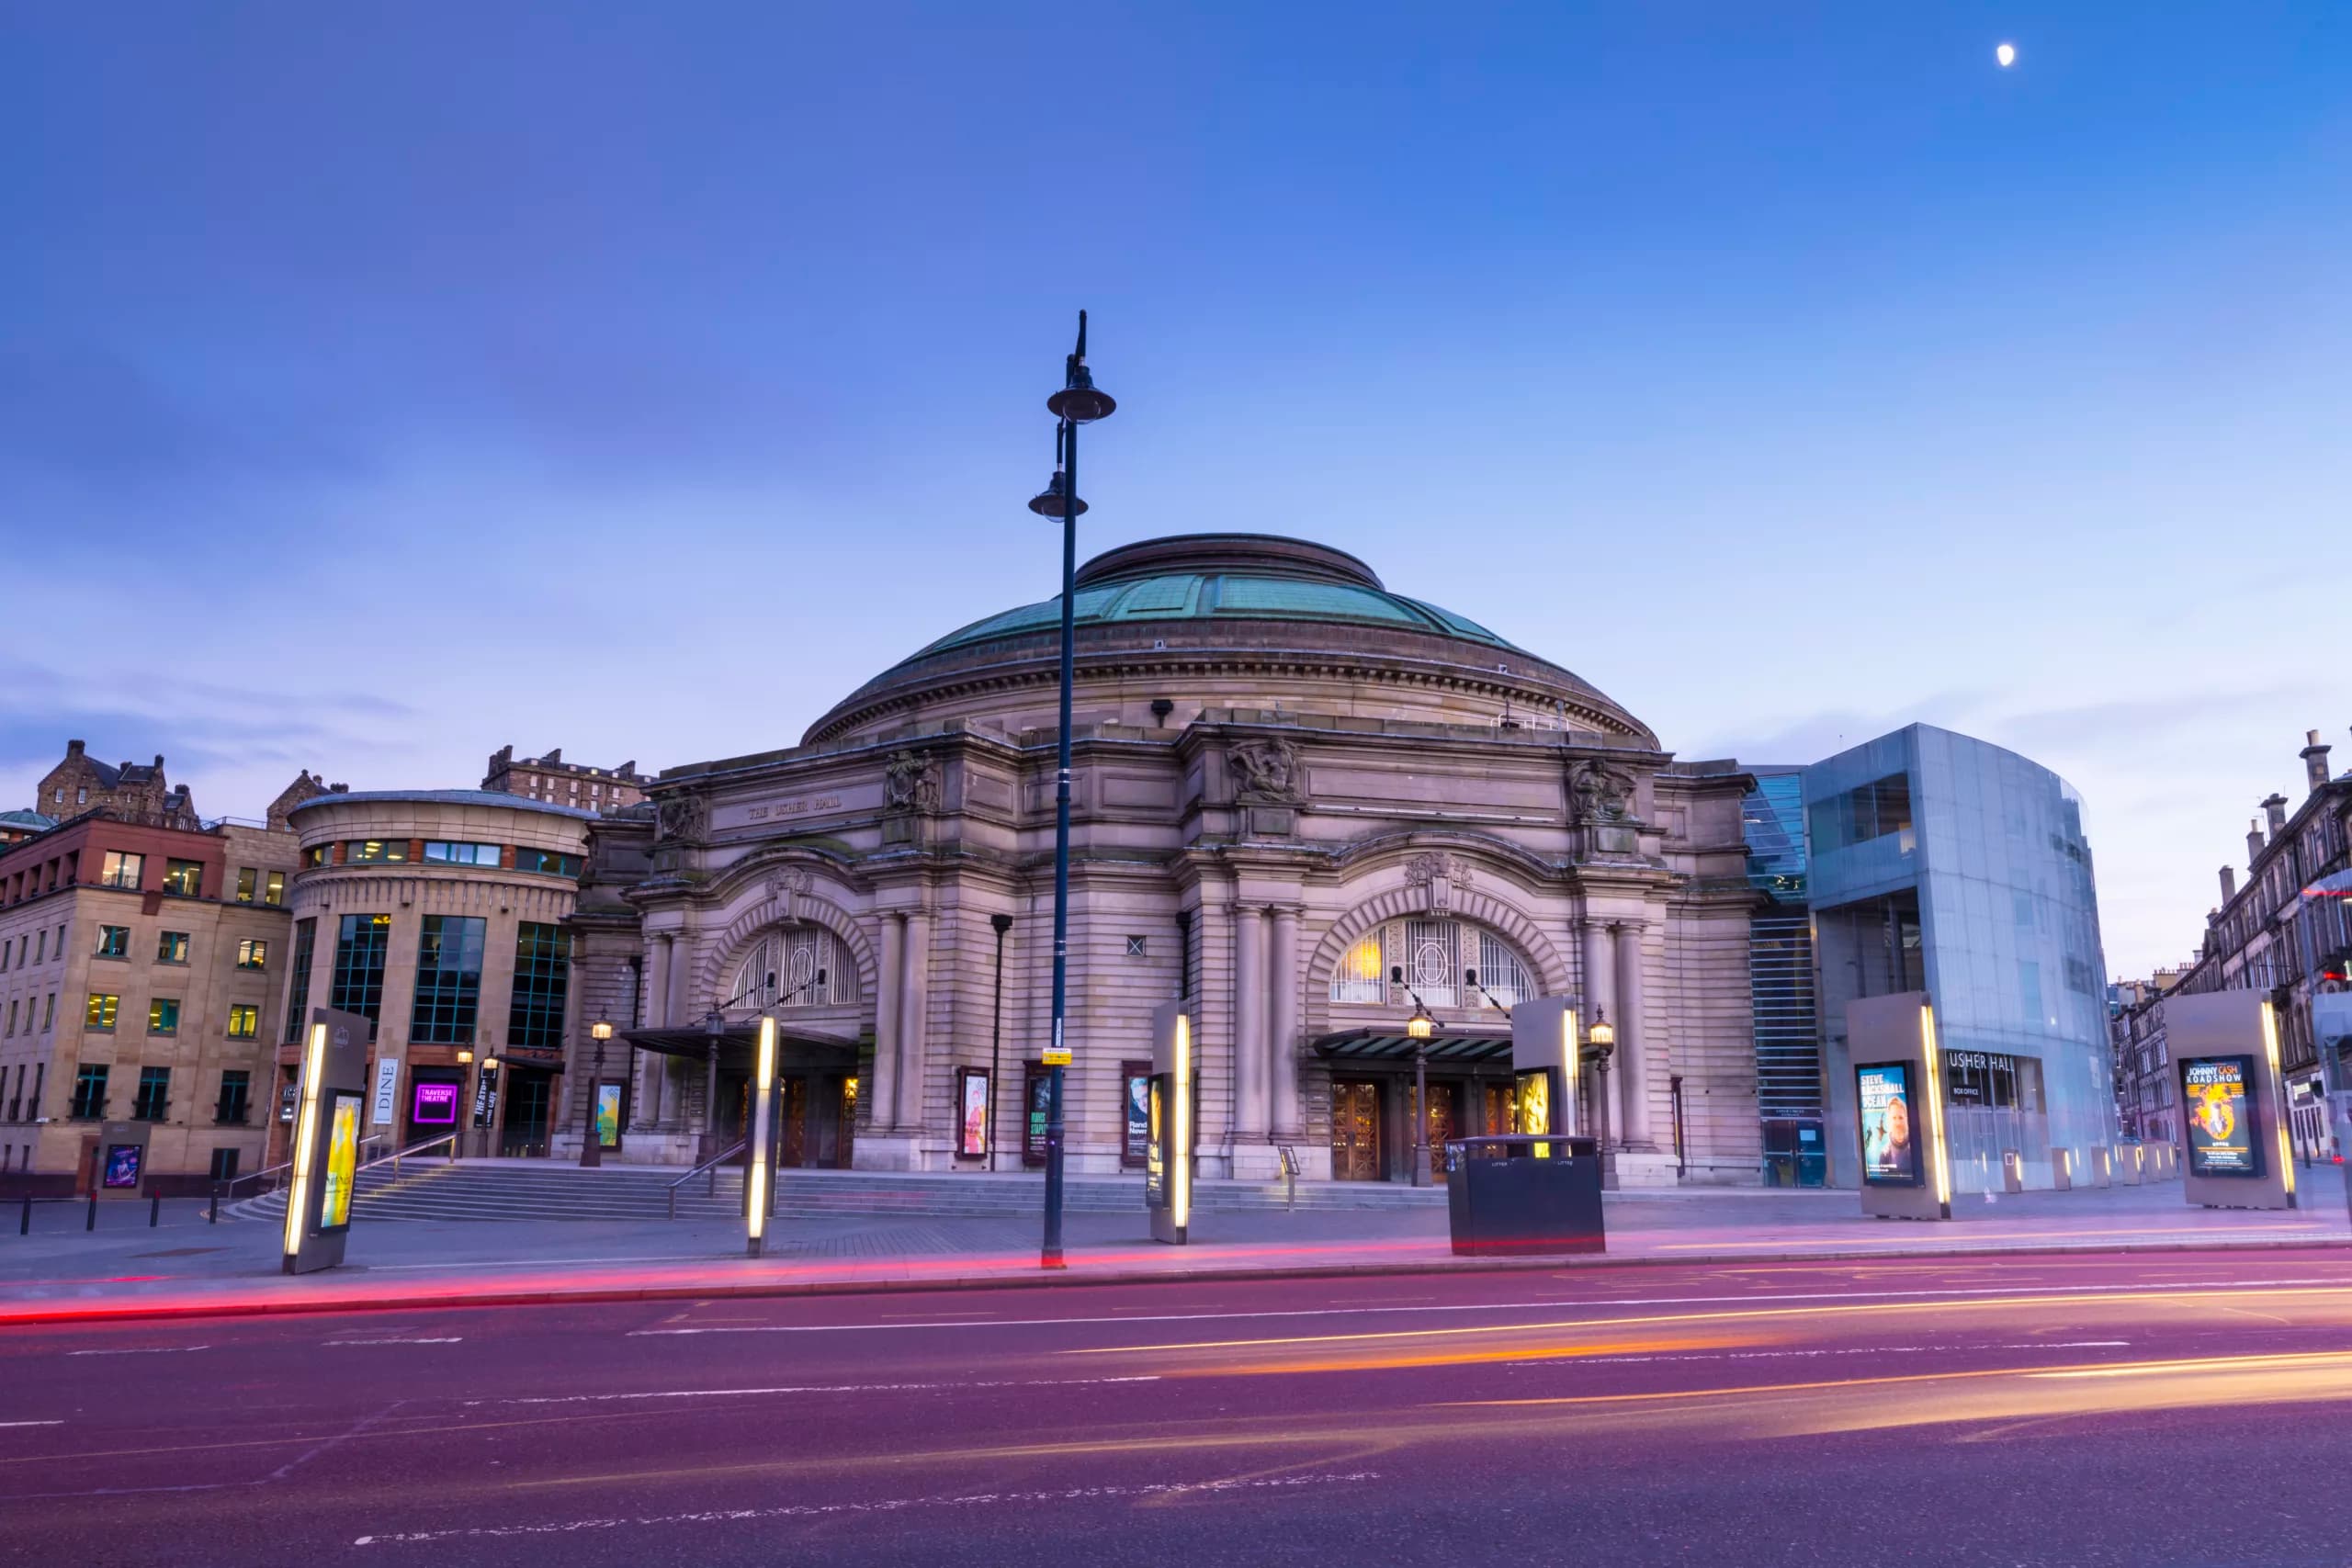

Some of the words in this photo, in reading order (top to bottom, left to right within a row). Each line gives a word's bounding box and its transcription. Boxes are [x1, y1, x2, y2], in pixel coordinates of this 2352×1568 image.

[749, 807, 769, 819] THE
[775, 800, 808, 817] USHER
[814, 795, 842, 810] HALL
[1950, 1052, 1986, 1069] USHER
[1990, 1055, 2015, 1072] HALL
[2189, 1066, 2217, 1076] JOHNNY
[2218, 1065, 2238, 1075] CASH
[1860, 1074, 1883, 1085] STEVE
[2187, 1074, 2242, 1083] ROADSHOW
[378, 1066, 394, 1111] DINE
[1953, 1087, 1963, 1095] BOX
